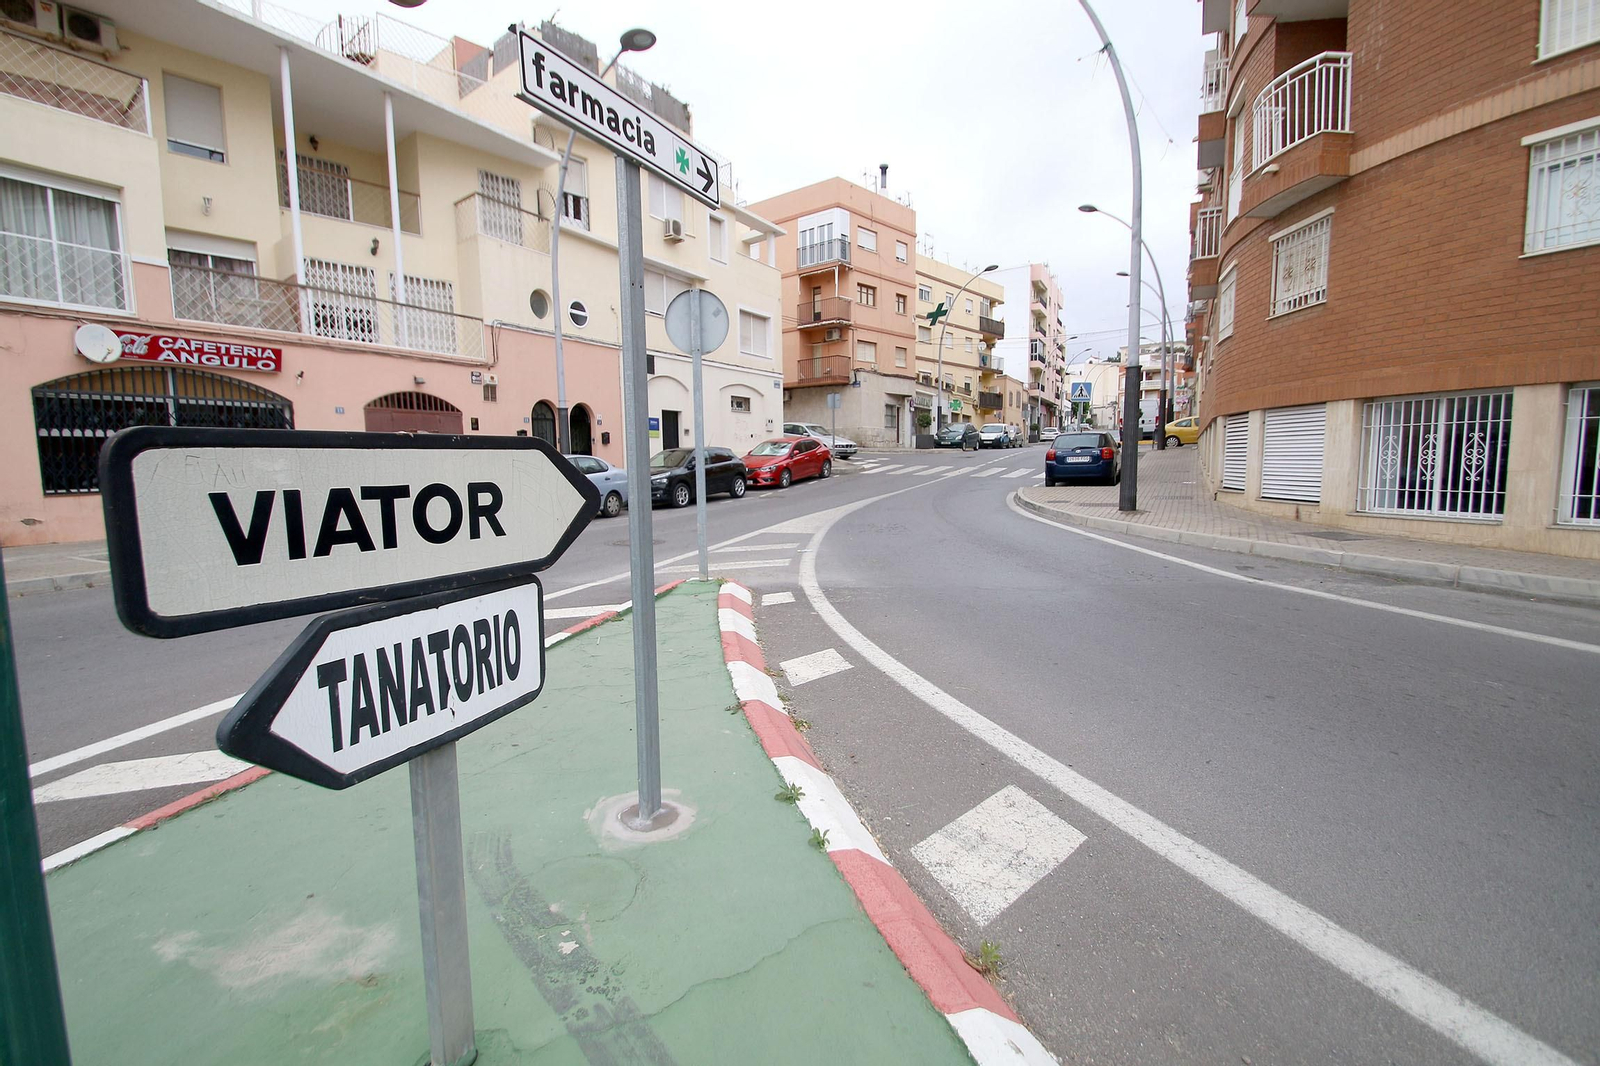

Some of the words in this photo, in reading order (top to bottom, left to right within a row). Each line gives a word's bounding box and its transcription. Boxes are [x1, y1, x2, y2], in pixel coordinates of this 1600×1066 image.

[531, 51, 657, 157] farmacia
[157, 349, 275, 370] ANGULO
[158, 337, 275, 358] CAFETERIA
[207, 481, 507, 567] VIATOR
[316, 609, 521, 751] TANATORIO
